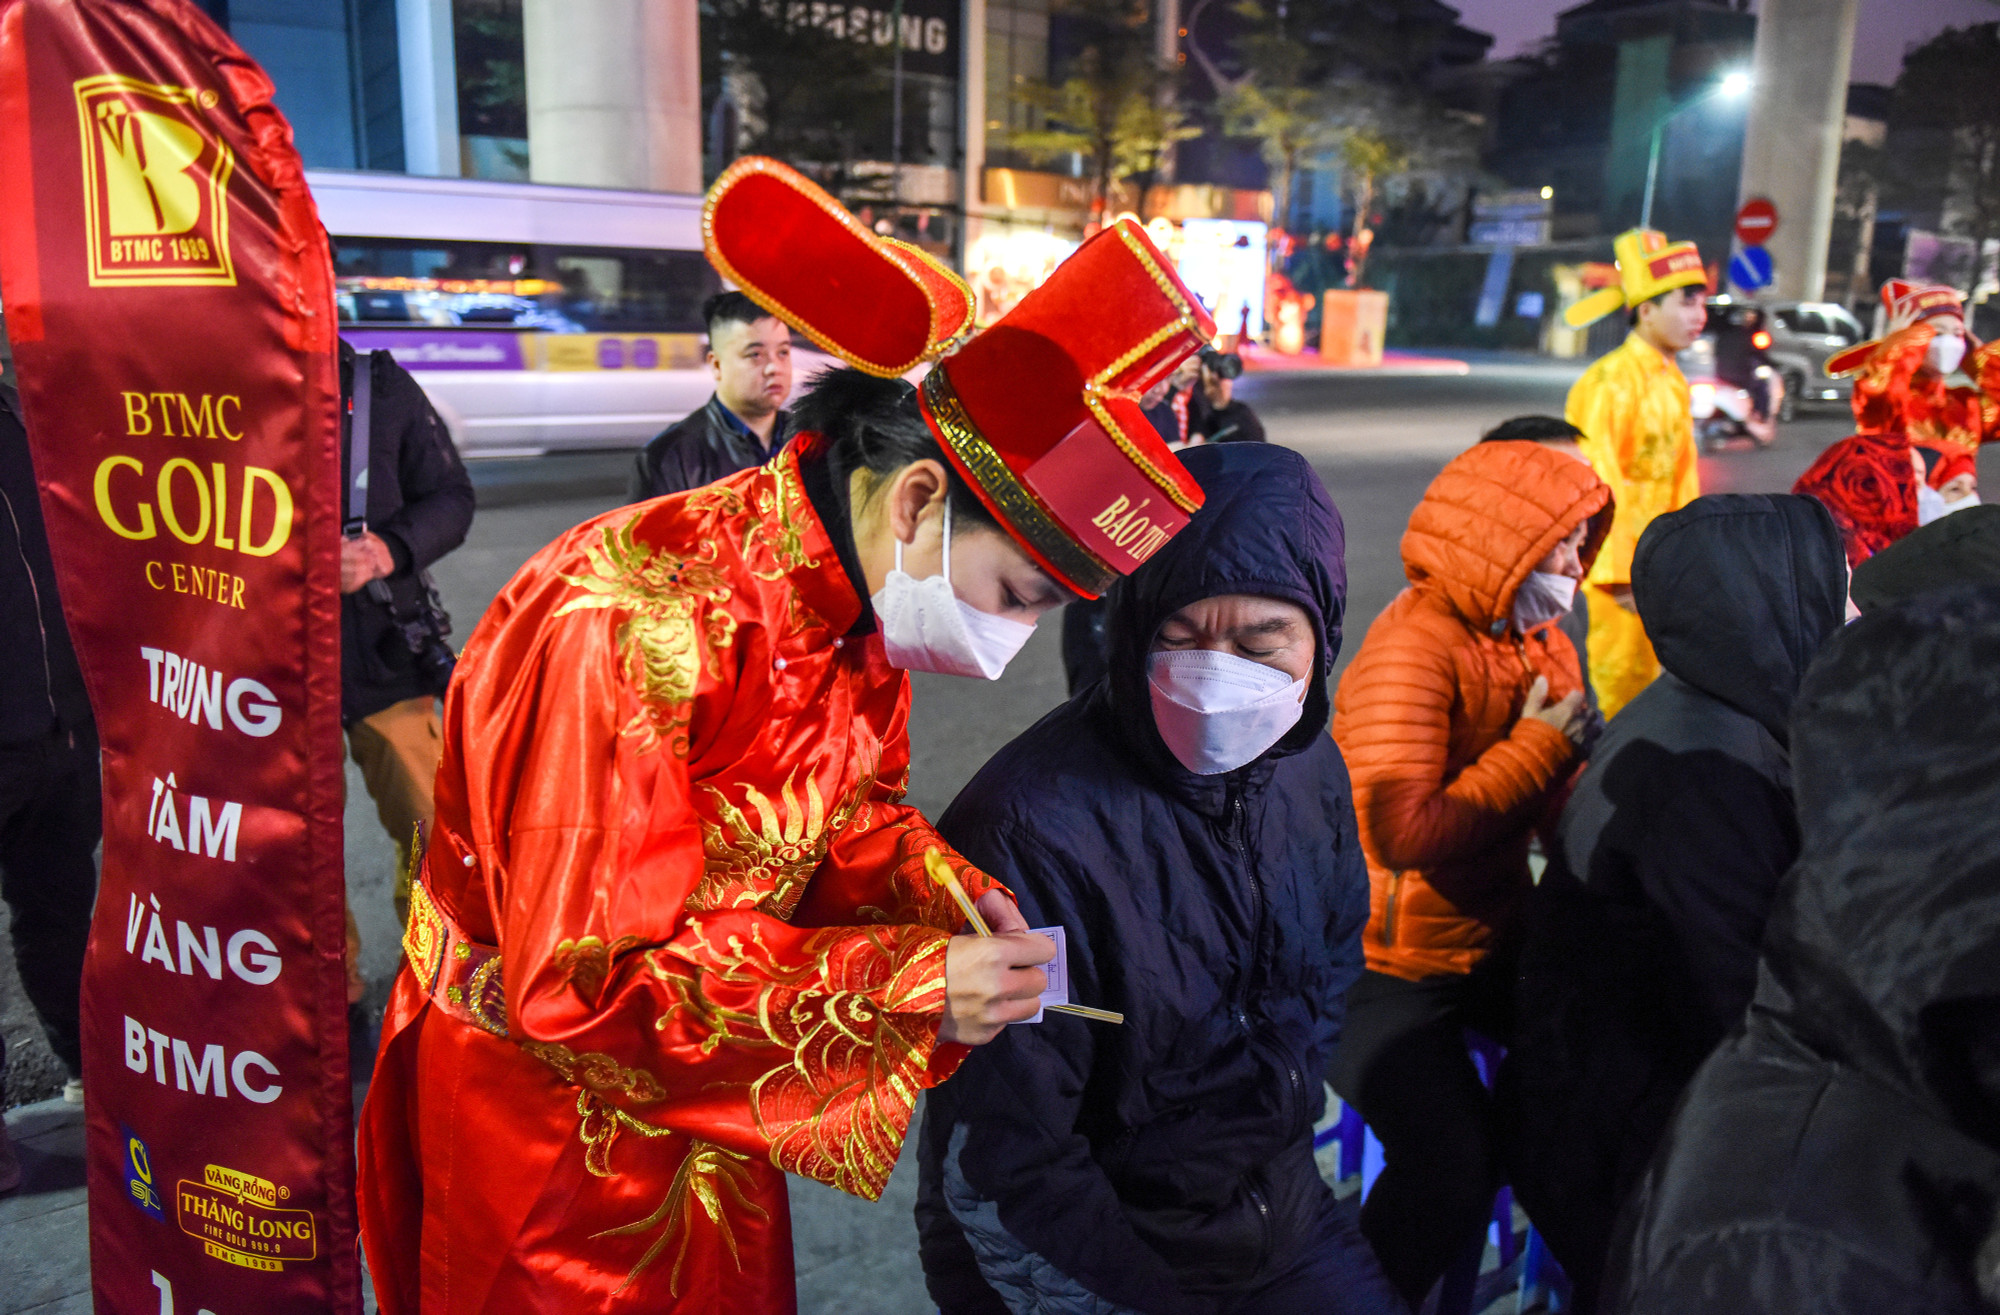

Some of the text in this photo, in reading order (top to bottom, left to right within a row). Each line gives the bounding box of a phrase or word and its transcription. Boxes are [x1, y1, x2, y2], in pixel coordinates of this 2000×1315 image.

[110, 237, 210, 262] BTMC 1989
[121, 391, 244, 441] BTMC
[93, 455, 294, 557] GOLD
[145, 561, 246, 610] CENTER
[140, 646, 283, 738] TRUNG
[147, 771, 243, 863] TÂM
[125, 891, 283, 986] VÀNG
[124, 1014, 284, 1104] BTMC
[206, 1168, 275, 1202] VÀNG RỒNG
[181, 1192, 311, 1240] THĂNG LONG
[204, 1223, 281, 1254] FINE GOLD 999.9
[208, 1244, 276, 1270] BTMC 1989
